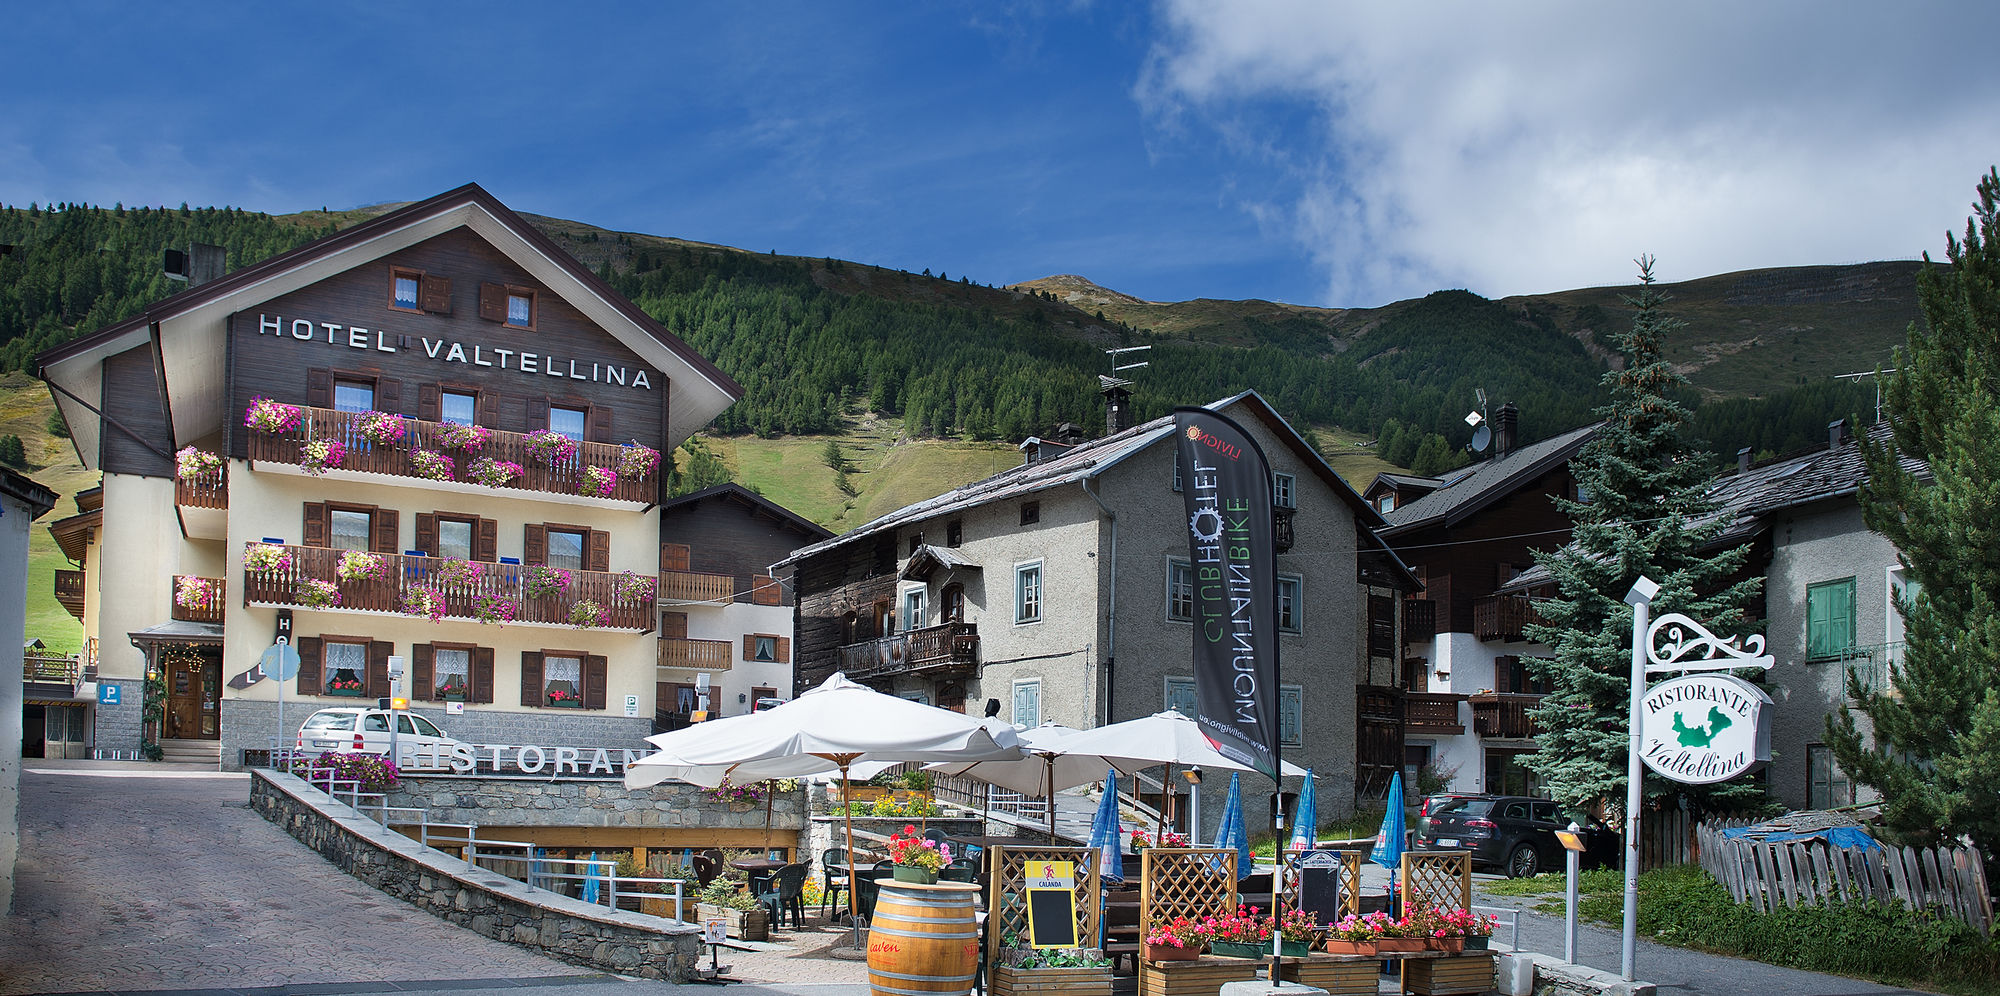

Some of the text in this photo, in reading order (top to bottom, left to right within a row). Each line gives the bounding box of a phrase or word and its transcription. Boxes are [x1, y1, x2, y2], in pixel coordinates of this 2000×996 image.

[259, 313, 652, 390] HOTEL VALTELLINA
[107, 686, 116, 699] P
[1648, 684, 1751, 718] RISTORANTE
[1645, 738, 1746, 777] Valtellina
[1038, 880, 1062, 888] CALANDA
